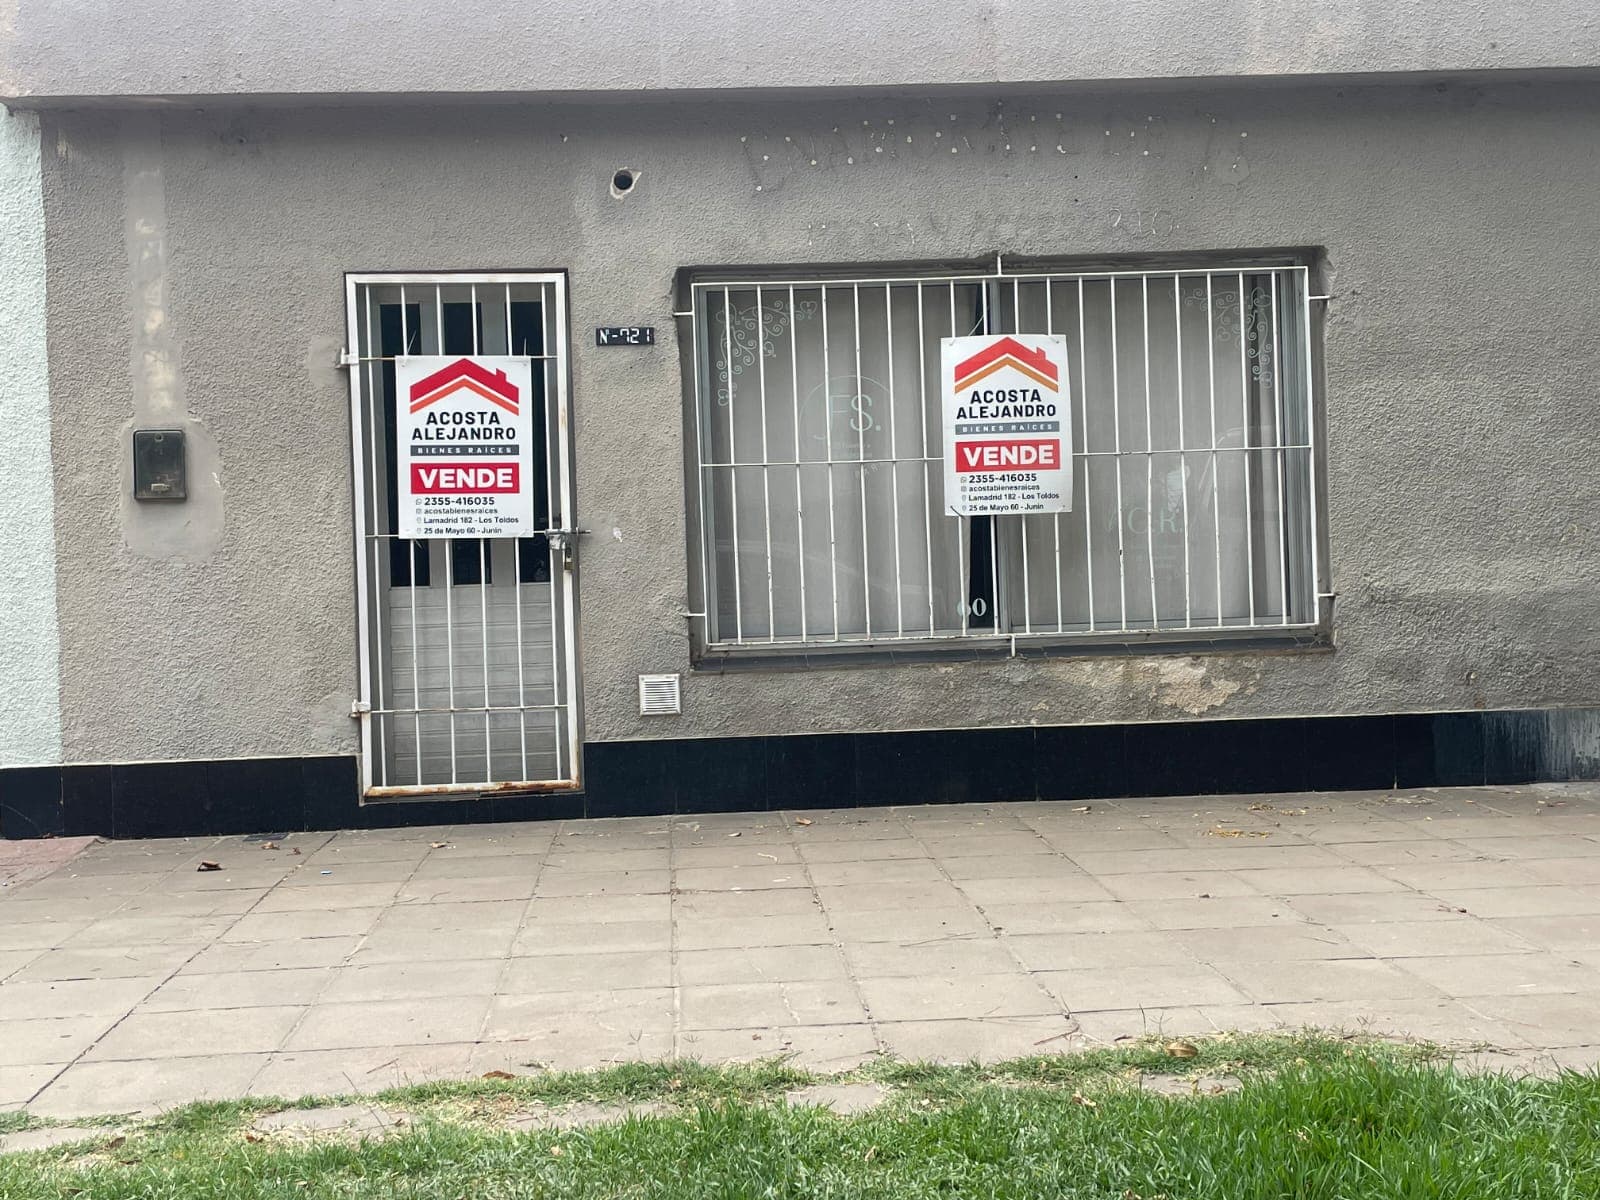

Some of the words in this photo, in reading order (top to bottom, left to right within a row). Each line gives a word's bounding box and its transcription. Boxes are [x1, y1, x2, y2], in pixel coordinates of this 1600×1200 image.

[970, 389, 1042, 404] ACOSTA
[956, 404, 1056, 420] ALEJANDRO
[426, 411, 501, 425] ACOSTA
[412, 427, 516, 441] ALEJANDRO
[962, 425, 1004, 433] BIENES
[963, 444, 1054, 467] VENDE
[418, 468, 513, 489] VENDE
[968, 473, 1037, 484] 2355-416035
[424, 496, 495, 506] 2355-416035
[968, 494, 1002, 502] Lamadrid
[1021, 492, 1035, 500] Los
[1036, 492, 1060, 500] Toldos
[968, 504, 978, 512] 25
[978, 503, 988, 511] de
[989, 503, 1009, 513] Mayo
[423, 516, 458, 524] Lamadrid
[460, 516, 473, 524] 182
[478, 516, 492, 524] Los
[494, 516, 519, 524] Toldos
[445, 527, 465, 536] Mayo
